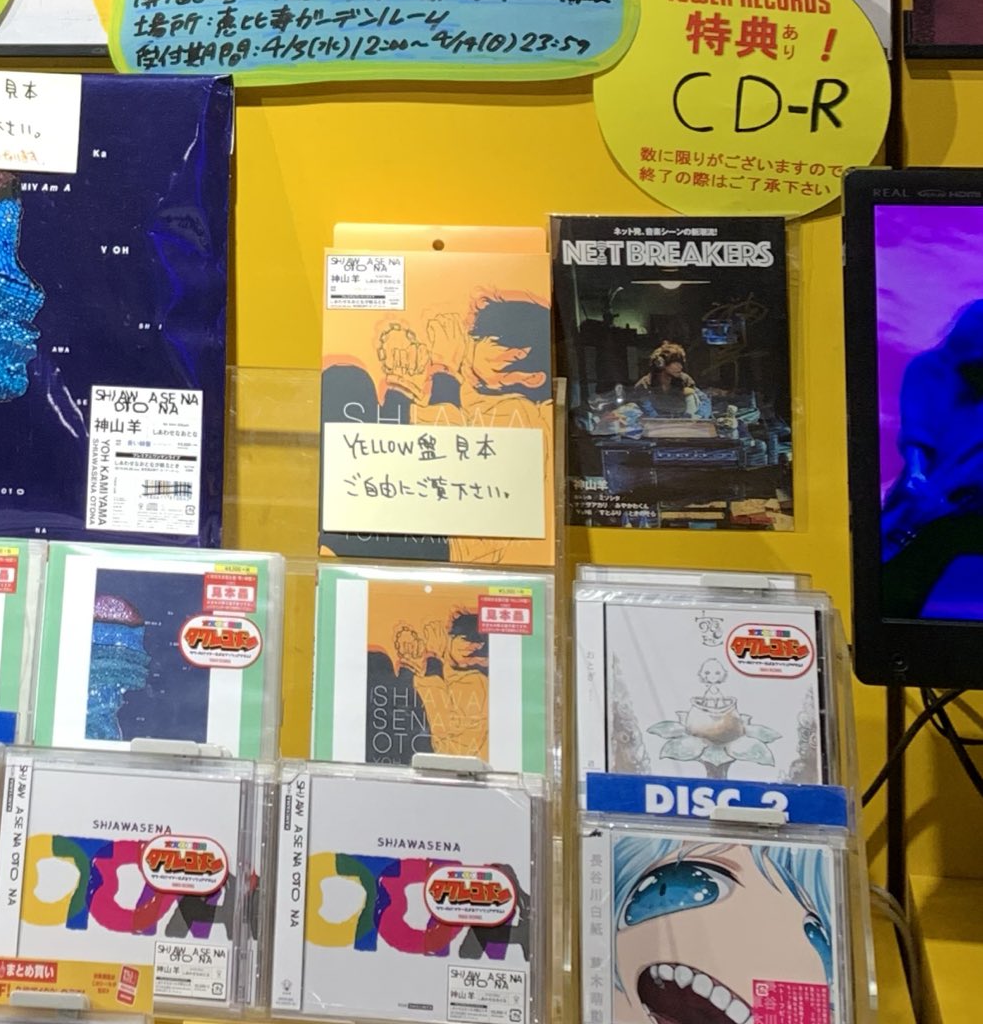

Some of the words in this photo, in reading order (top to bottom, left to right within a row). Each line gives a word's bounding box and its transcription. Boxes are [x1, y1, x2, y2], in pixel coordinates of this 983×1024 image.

[686, 10, 778, 60] 特典
[673, 72, 850, 133] CD-R
[640, 146, 843, 178] 数に限りがございますので
[639, 166, 831, 196] 終了の際はご了承下さい
[626, 241, 775, 267] BREAKERS
[94, 418, 142, 434] 神山羊
[101, 439, 110, 462] YOH
[456, 433, 497, 461] 見本
[98, 466, 109, 526] KAMIYAMA
[645, 784, 741, 817] DISC
[92, 820, 172, 834] SHIAWASENA
[377, 837, 460, 852] SHIAWASENA
[6, 963, 54, 978] まとめ買い
